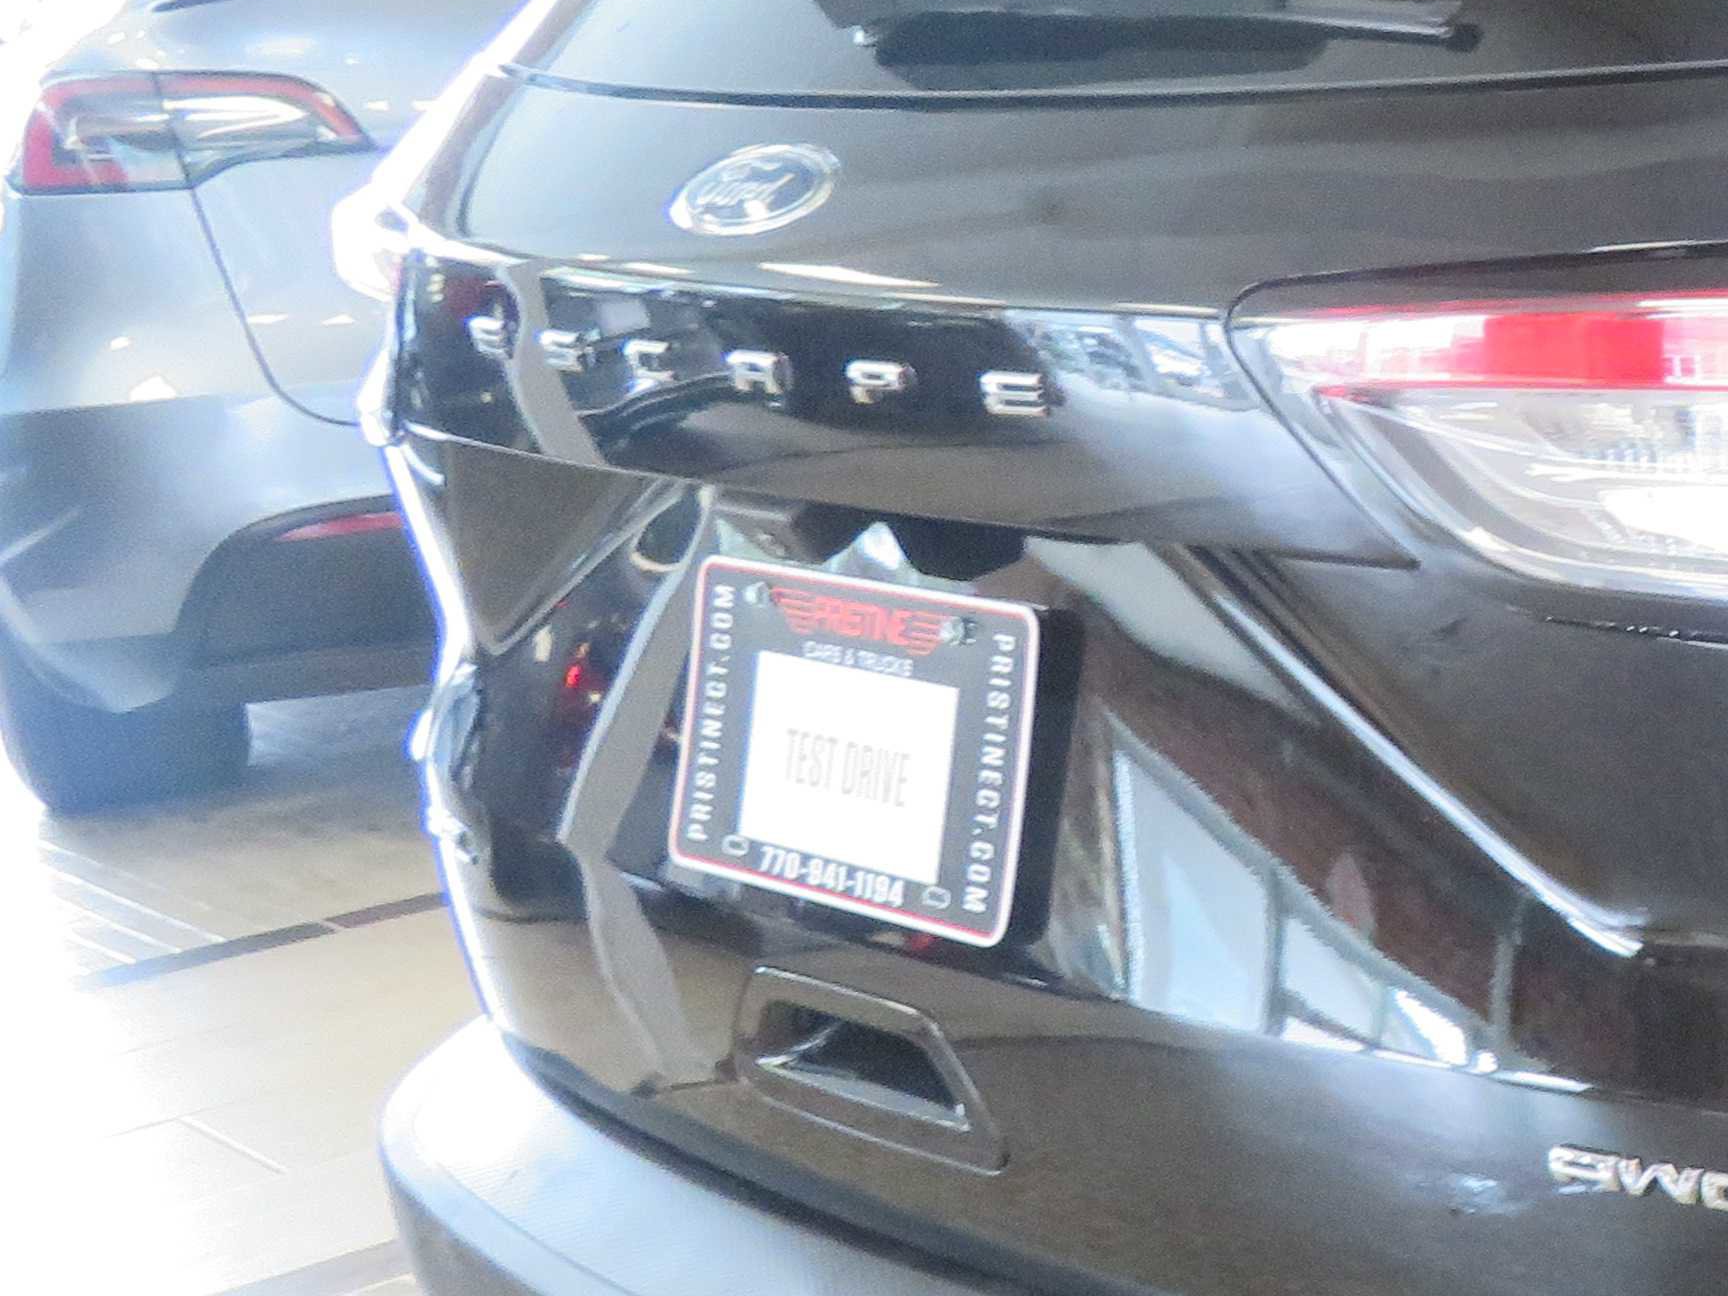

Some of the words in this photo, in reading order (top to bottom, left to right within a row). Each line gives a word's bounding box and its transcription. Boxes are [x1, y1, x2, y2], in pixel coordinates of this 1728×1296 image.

[466, 315, 1051, 417] ESCAPE
[687, 584, 735, 841] PRISTINECT.COM
[787, 728, 838, 790] TEST
[841, 741, 910, 807] DRIVE
[963, 634, 1016, 913] PRISTINECT.COM
